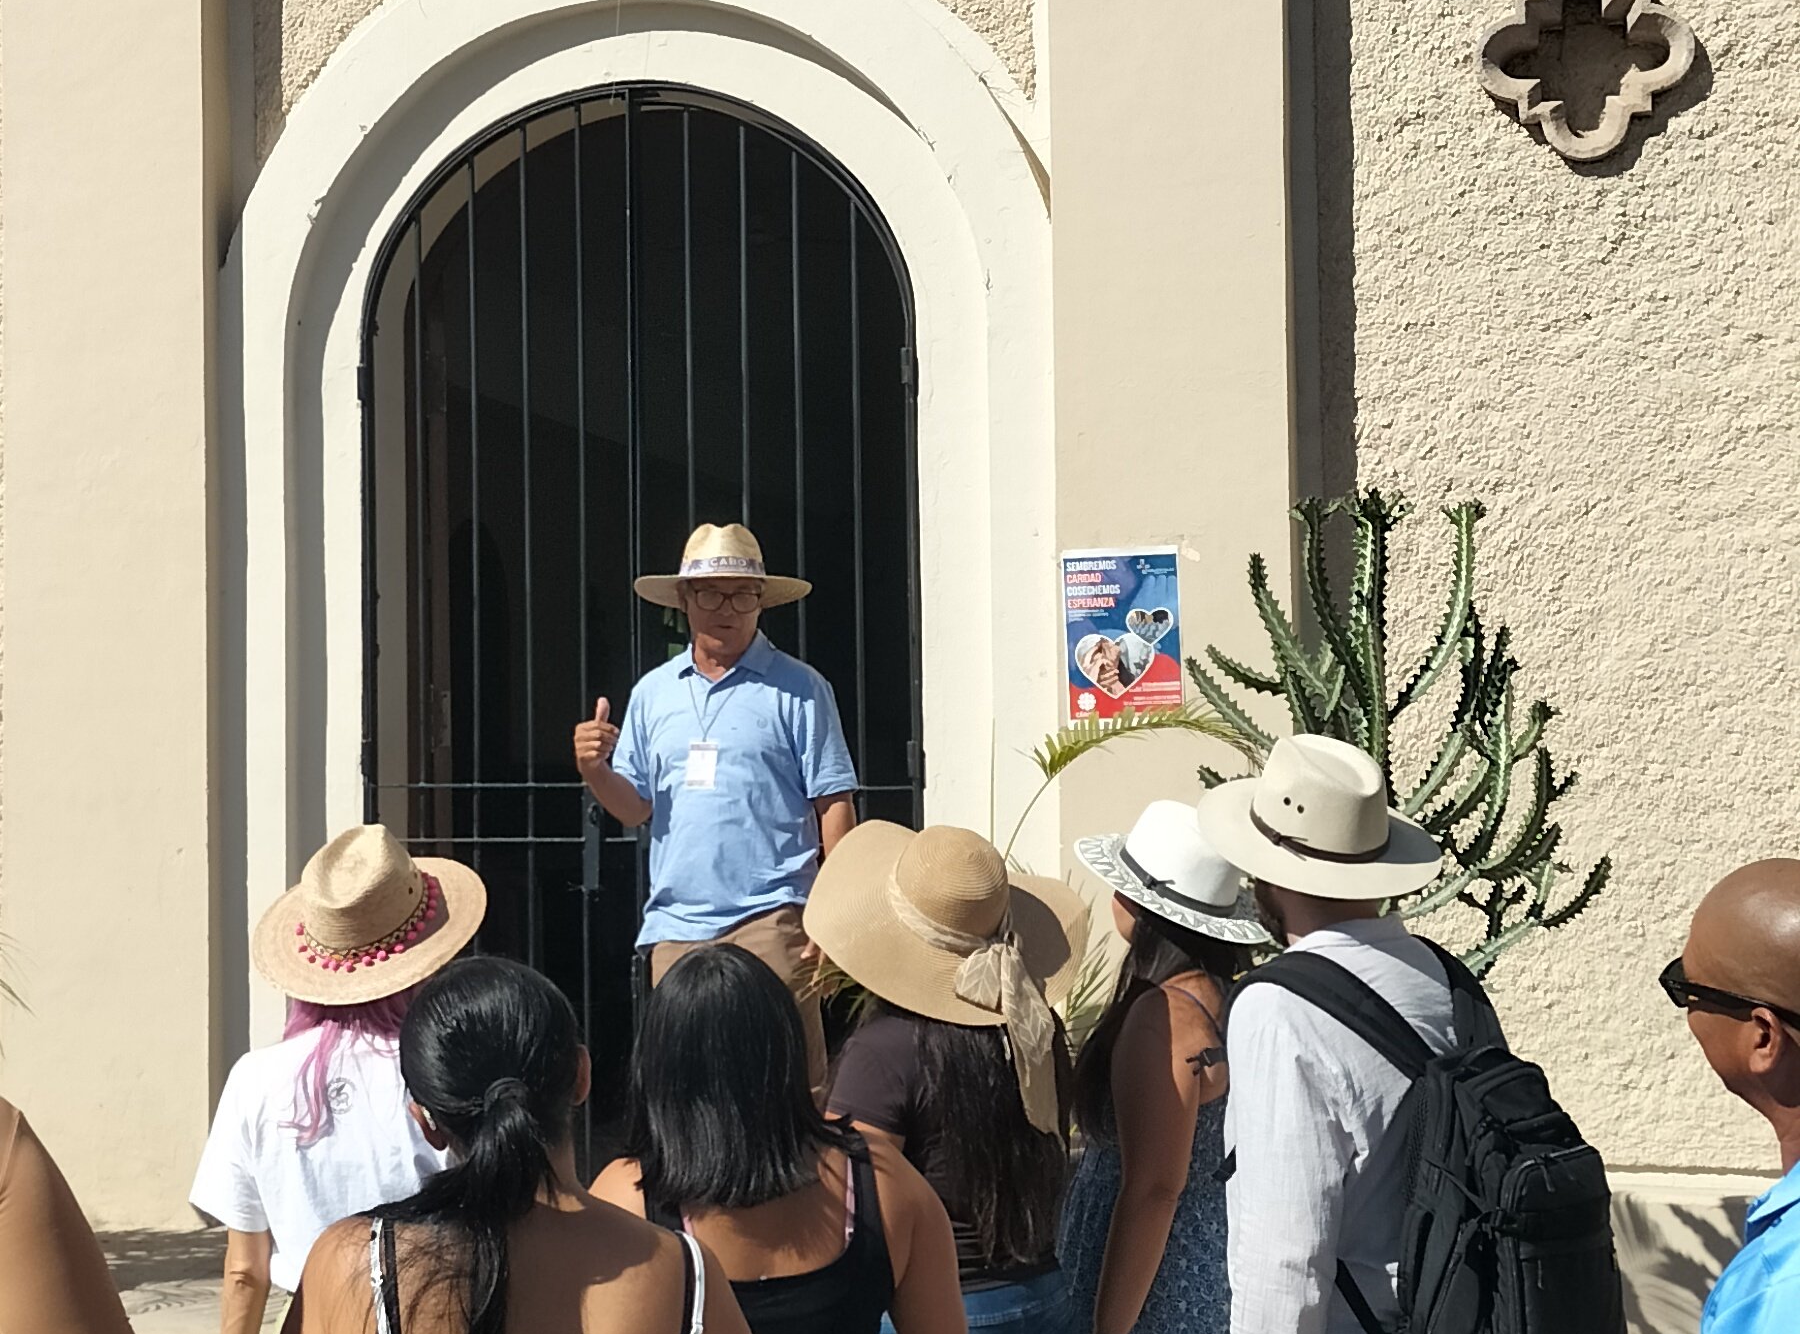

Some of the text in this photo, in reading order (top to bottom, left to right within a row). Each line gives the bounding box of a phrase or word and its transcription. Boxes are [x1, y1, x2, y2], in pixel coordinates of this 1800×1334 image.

[710, 557, 747, 567] CABO
[1066, 559, 1117, 572] SEMBREMOS
[1066, 572, 1102, 584] CARIDAD
[1067, 584, 1121, 596] COSECHEMOS
[1067, 597, 1116, 609] ESPERANZA
